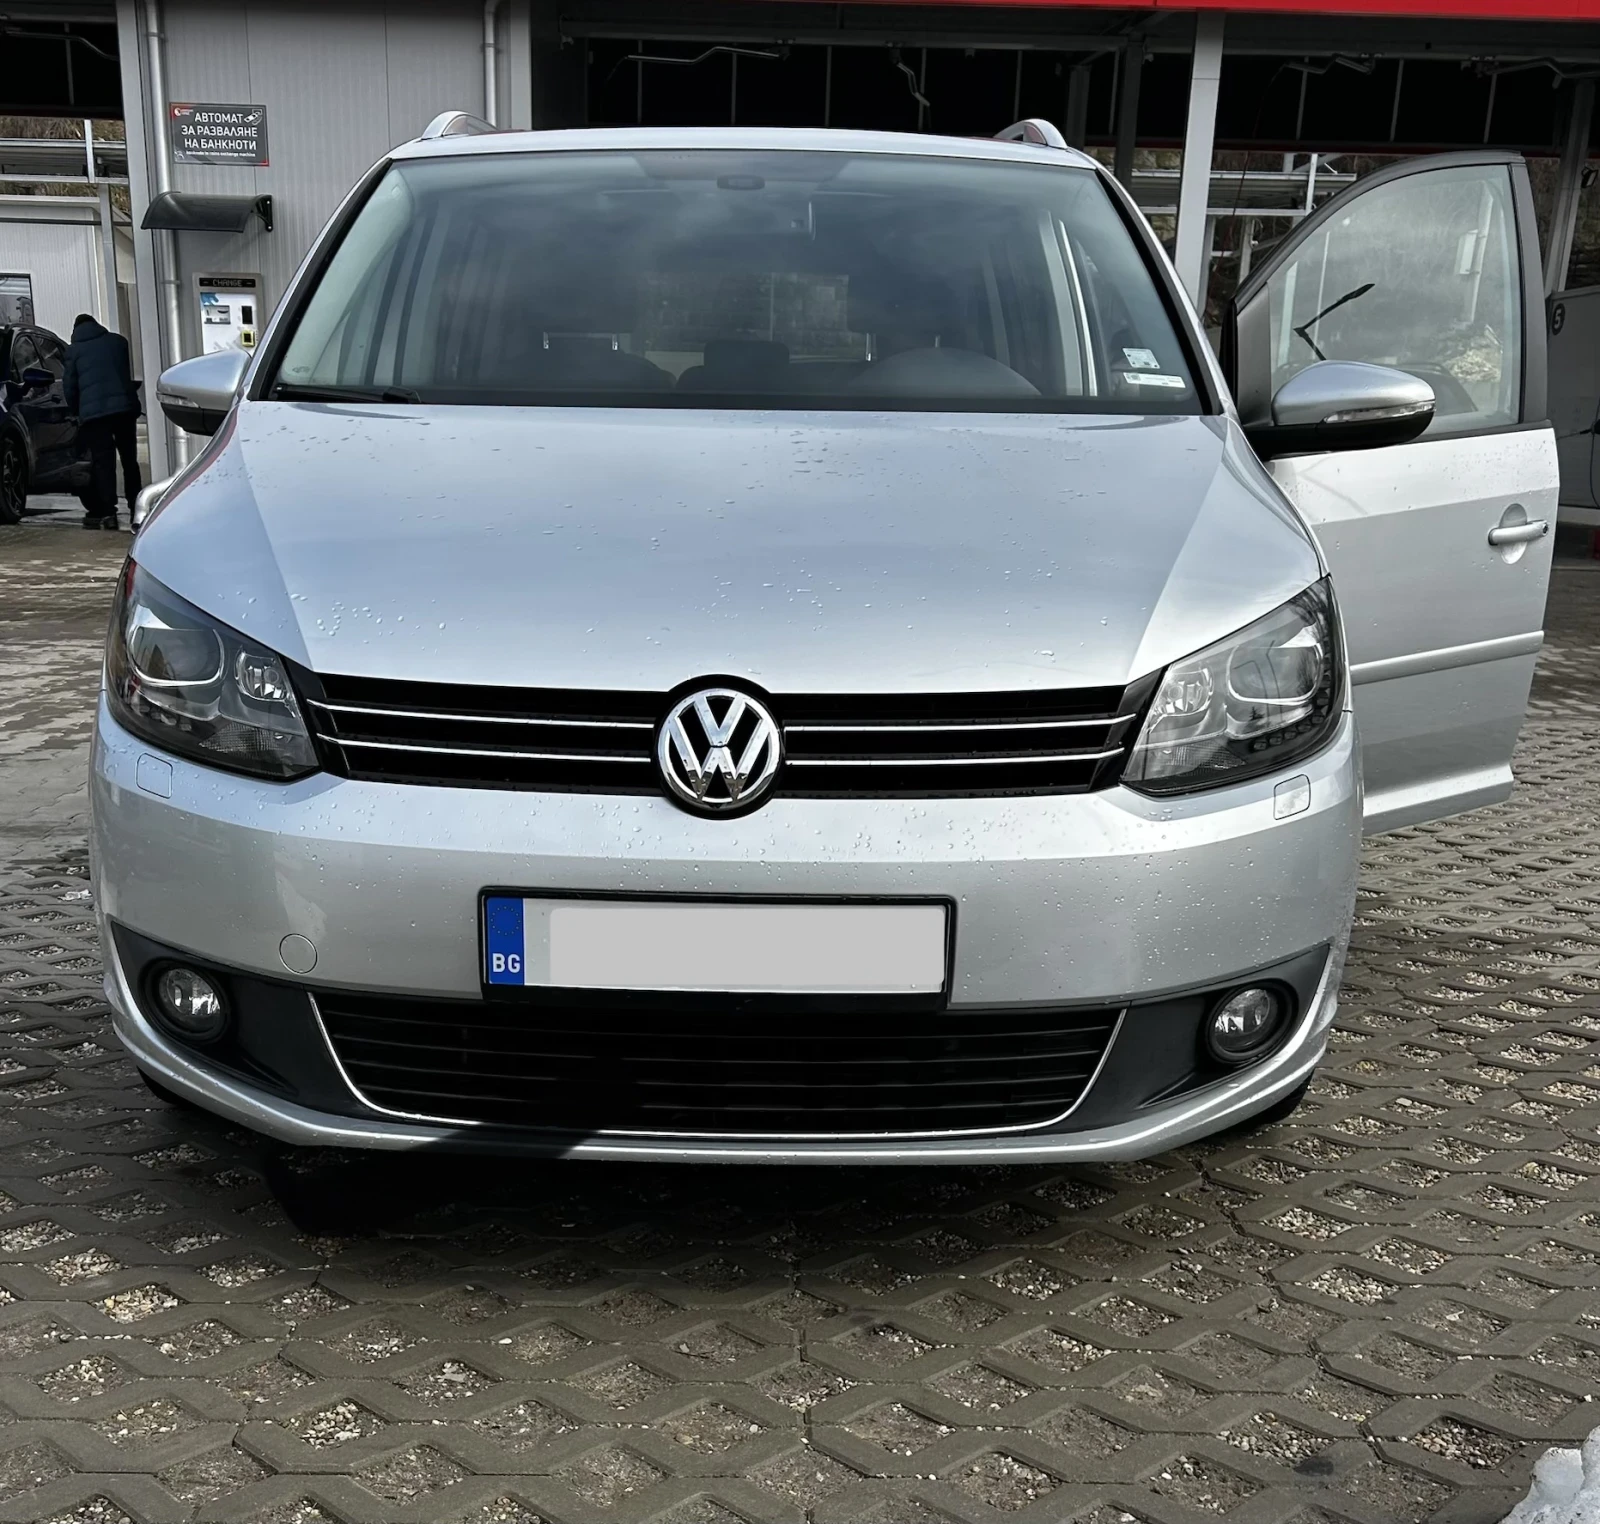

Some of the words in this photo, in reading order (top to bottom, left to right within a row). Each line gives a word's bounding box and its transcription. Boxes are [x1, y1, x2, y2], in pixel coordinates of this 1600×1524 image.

[194, 112, 243, 123] АВТОМАТ
[181, 125, 195, 135] ЗА
[197, 126, 258, 137] РАЗВАЛЯНЕ
[184, 138, 199, 148] НА
[201, 139, 256, 150] БАНКНОТИ
[212, 279, 242, 287] CHANGE
[1554, 308, 1562, 329] 5
[492, 952, 521, 974] BG
